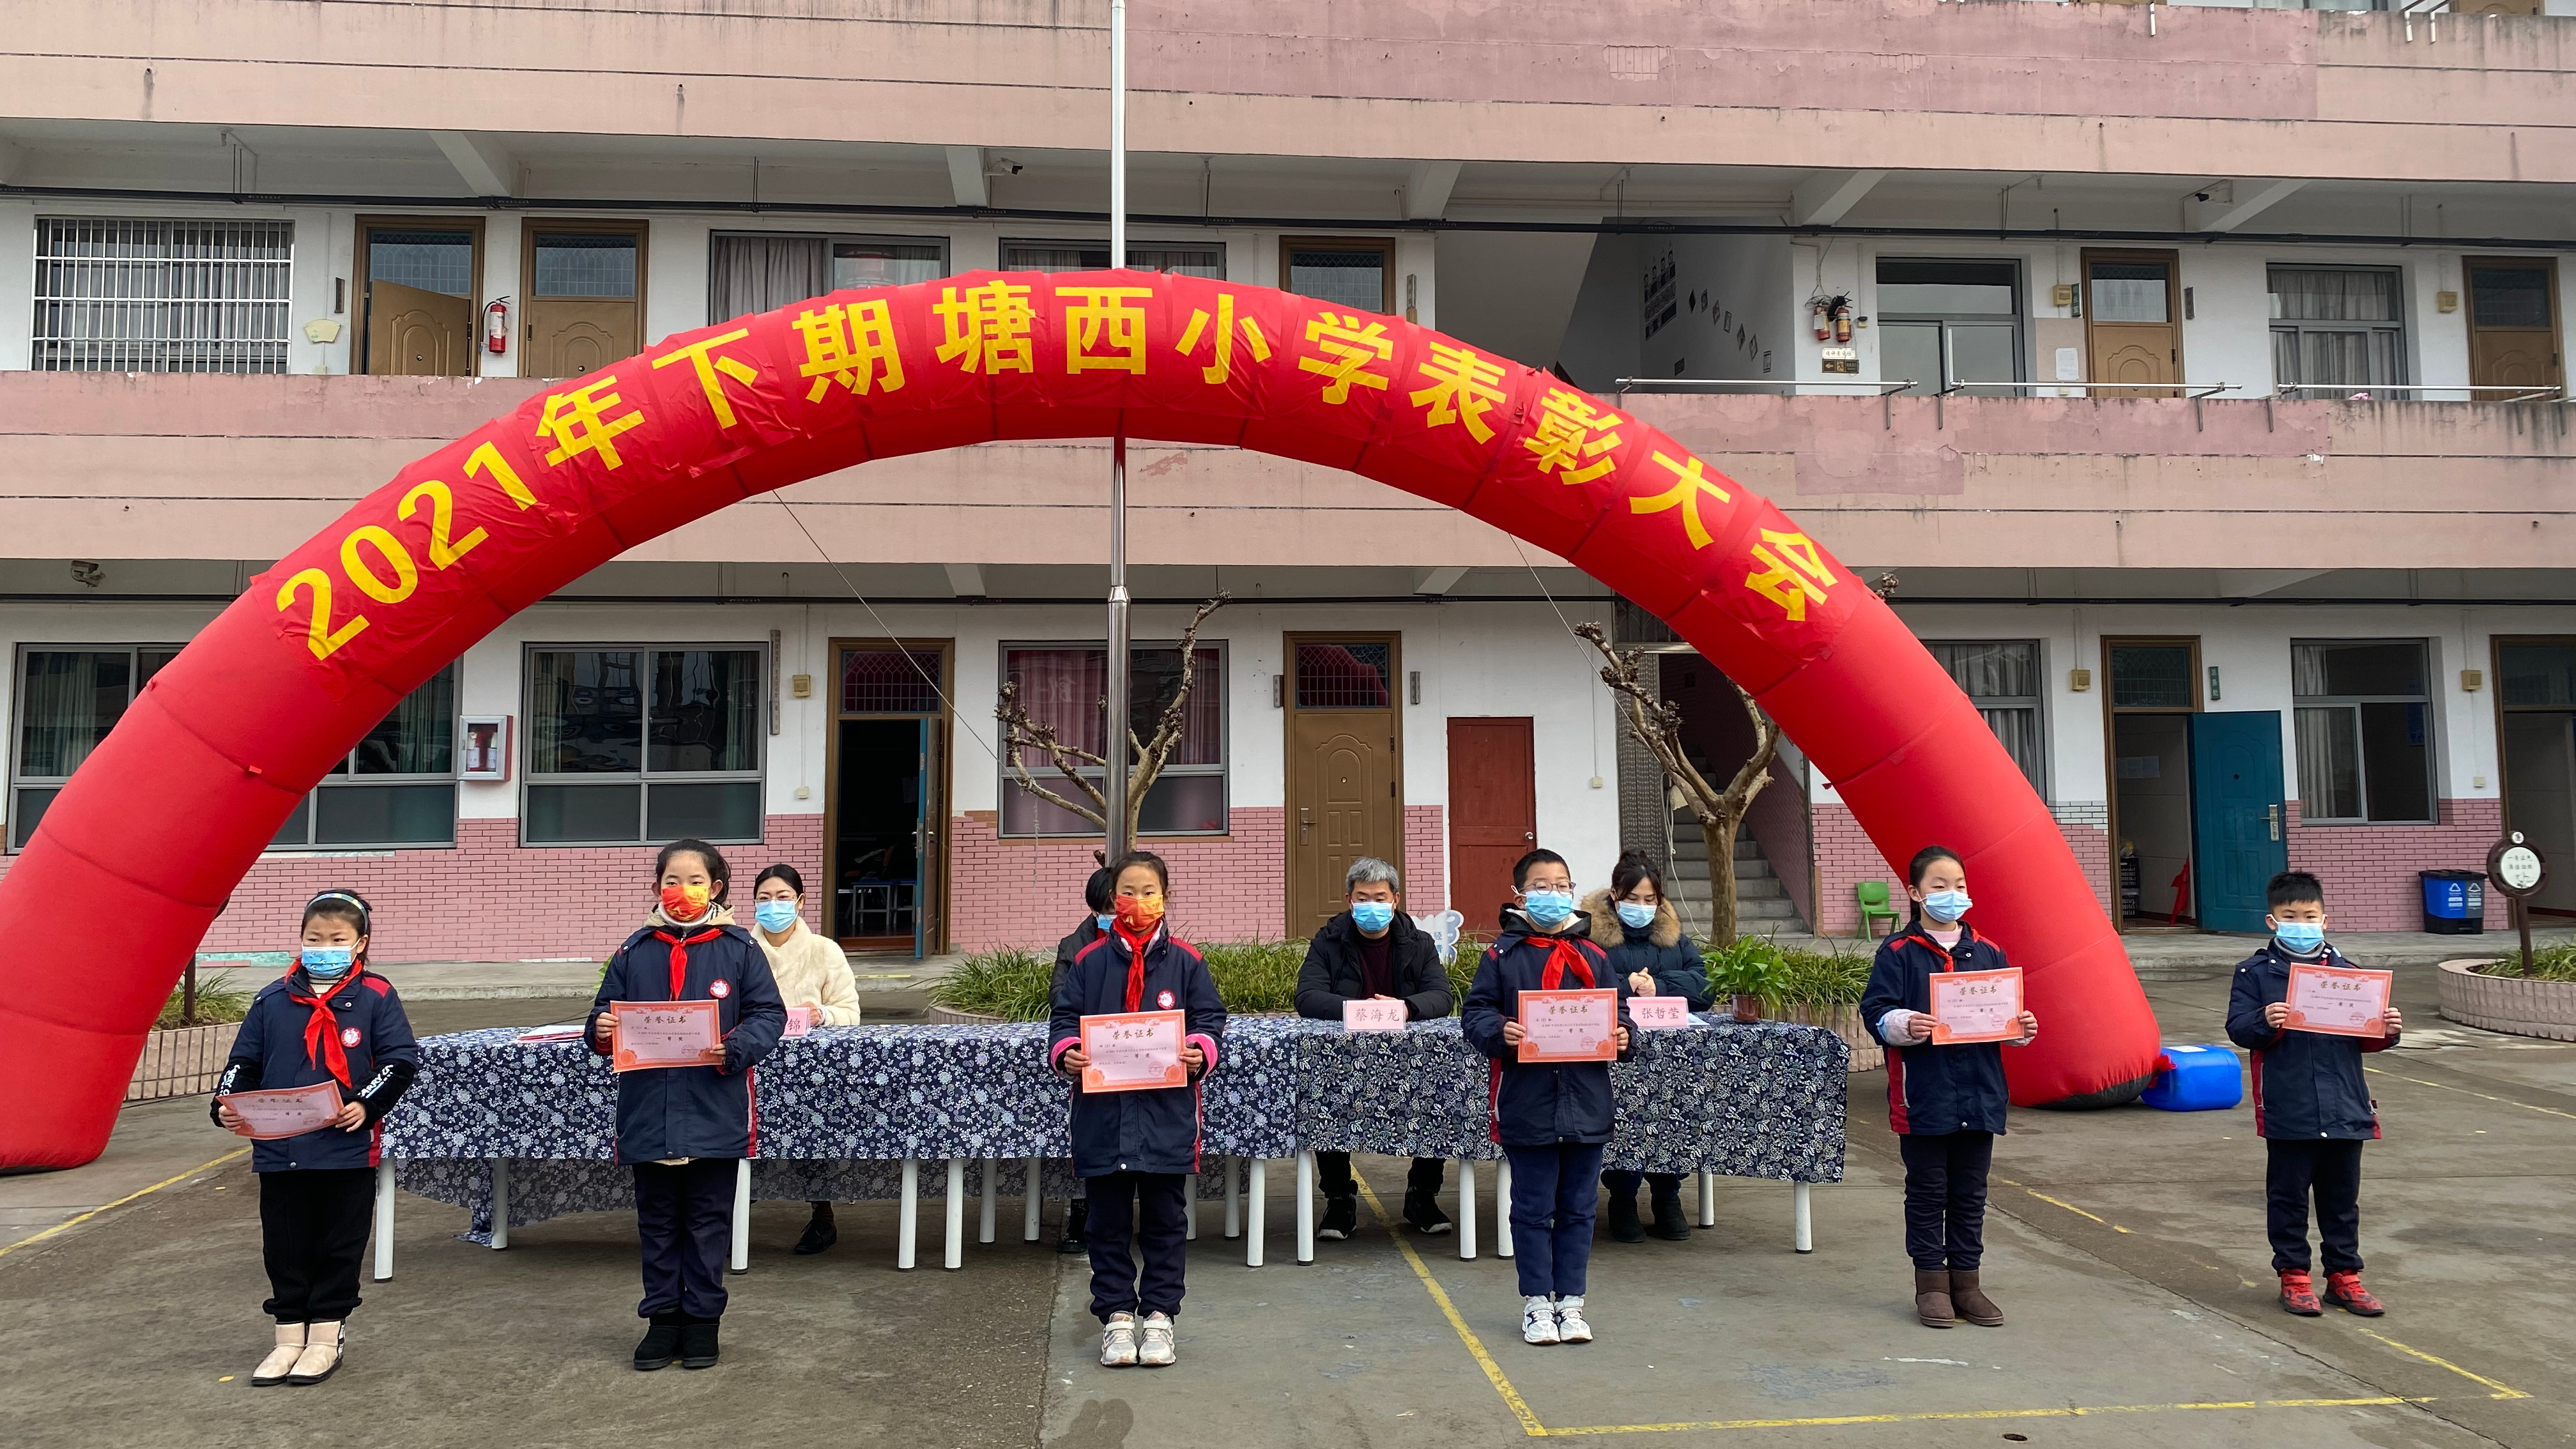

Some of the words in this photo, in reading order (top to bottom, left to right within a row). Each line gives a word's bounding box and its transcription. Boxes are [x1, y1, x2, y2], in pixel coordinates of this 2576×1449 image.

[275, 279, 1838, 661] 2021年下期塘西小学表彰大会
[1959, 985, 1997, 995] 荣誉证书
[2320, 981, 2361, 991] 荣誉证书
[1354, 1008, 1400, 1022] 蔡海龙
[1549, 1005, 1588, 1015] 荣誉证书
[1641, 1007, 1680, 1020] 张哲莹
[644, 1015, 687, 1023] 荣誉证书
[1112, 1028, 1154, 1039] 荣誉证书
